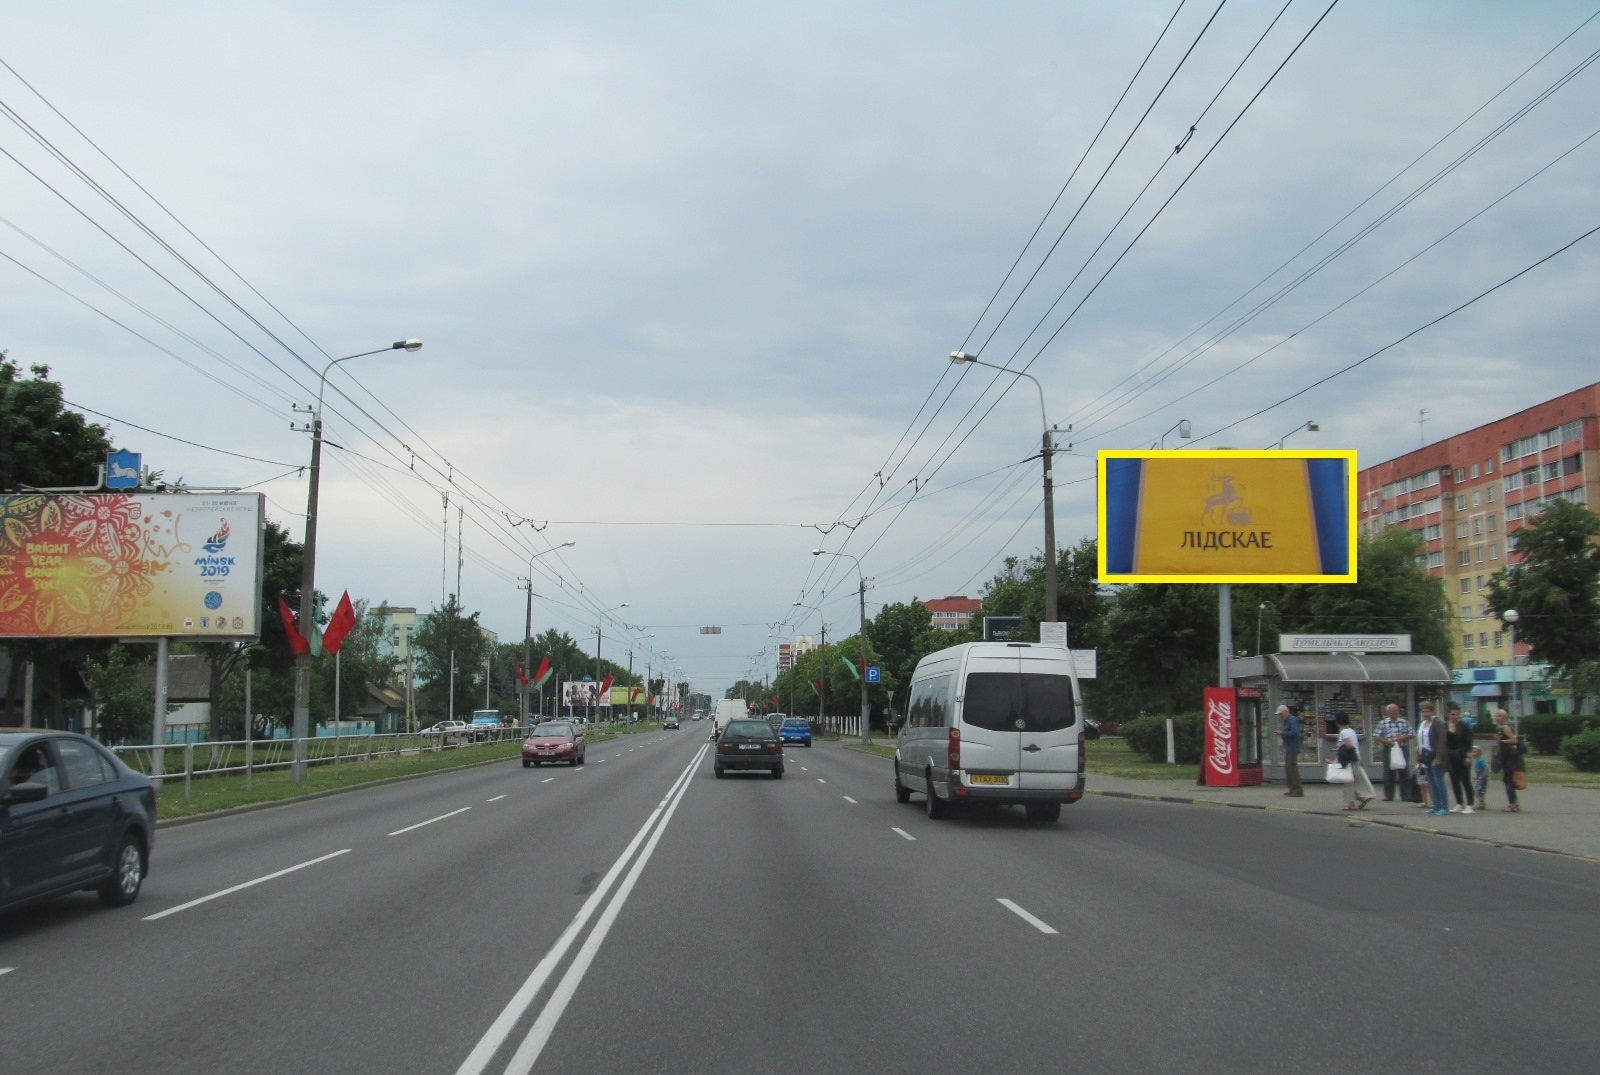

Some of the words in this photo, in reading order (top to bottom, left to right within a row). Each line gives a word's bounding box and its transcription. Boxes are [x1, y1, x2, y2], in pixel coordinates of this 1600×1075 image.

[1181, 531, 1273, 550] ЛІДСКАЕ
[26, 542, 70, 554] BRIGHT
[31, 555, 63, 566] YEAR
[194, 555, 236, 565] MINSK
[25, 566, 67, 578] BRIG
[200, 565, 230, 576] 2019
[869, 669, 878, 681] P
[1208, 698, 1233, 775] Coca-Cola
